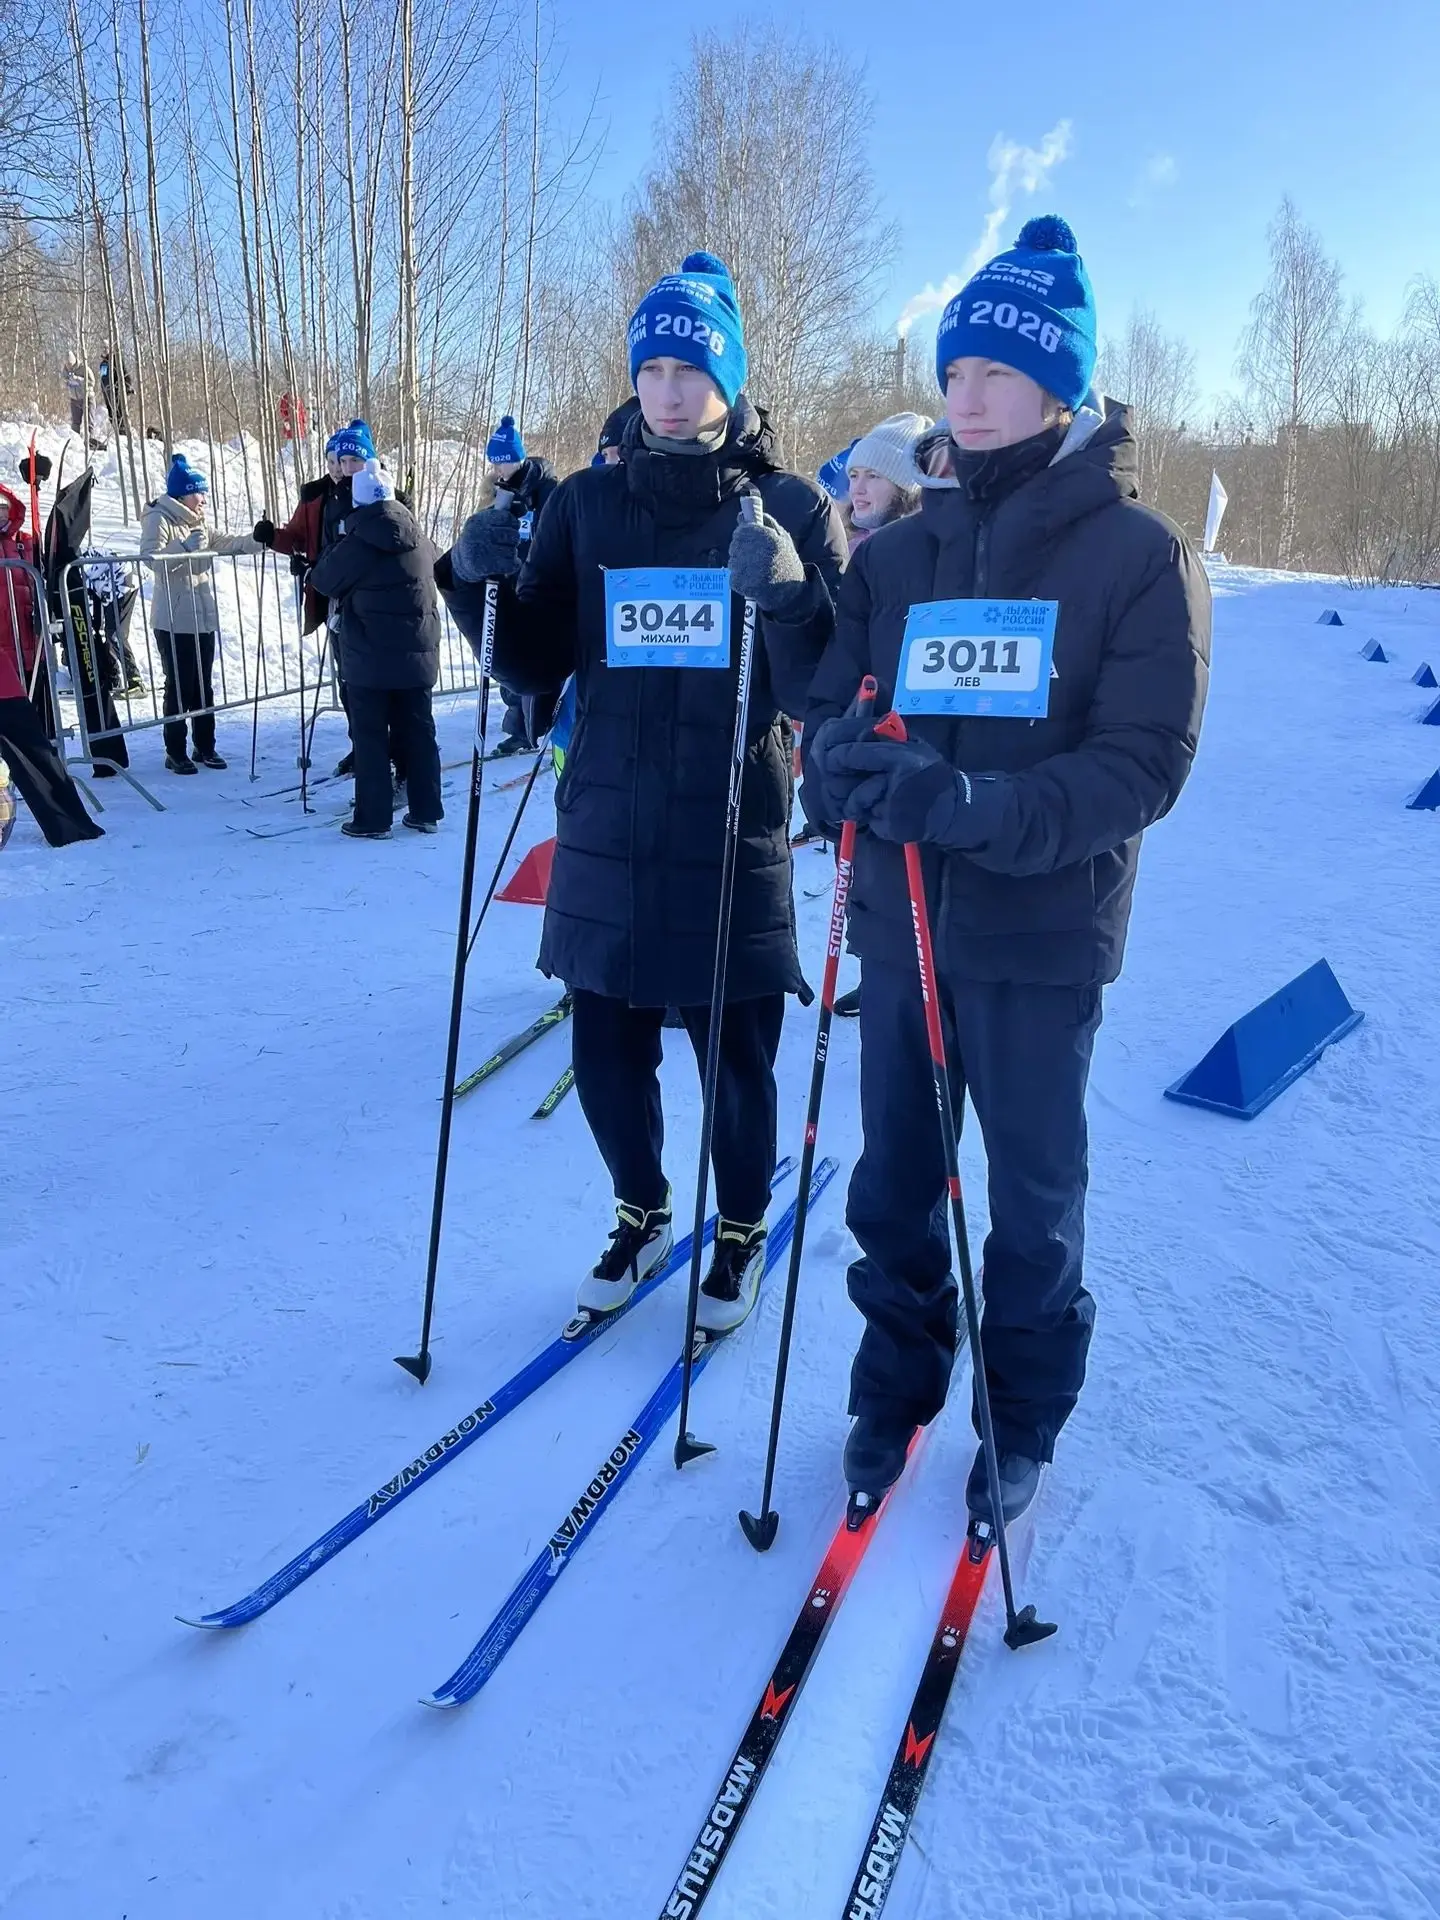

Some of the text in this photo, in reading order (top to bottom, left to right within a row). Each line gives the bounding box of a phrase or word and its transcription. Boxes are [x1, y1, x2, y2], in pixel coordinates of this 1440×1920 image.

[654, 313, 726, 357] 2026
[969, 300, 1062, 353] 2026
[620, 603, 715, 632] 3044
[1002, 615, 1045, 625] РОССИИ
[1004, 605, 1047, 616] ЛЫЖНЯ
[483, 609, 497, 674] NORDWAY
[640, 634, 690, 644] МИХАИЛ
[922, 640, 1021, 673] 3011
[737, 631, 749, 697] NORDWAY
[954, 676, 981, 687] ЛЕВ
[829, 857, 851, 958] MADSHUS
[817, 1031, 828, 1062] CT 90
[457, 1055, 502, 1093] FISCHER
[541, 1068, 575, 1110] FISCHER
[367, 1399, 496, 1518] NORDWAY
[549, 1427, 643, 1561] NORDWAY
[481, 1588, 540, 1667] BASE TUNING
[666, 1755, 757, 1920] MADSHUS
[849, 1802, 907, 1920] MADSH
